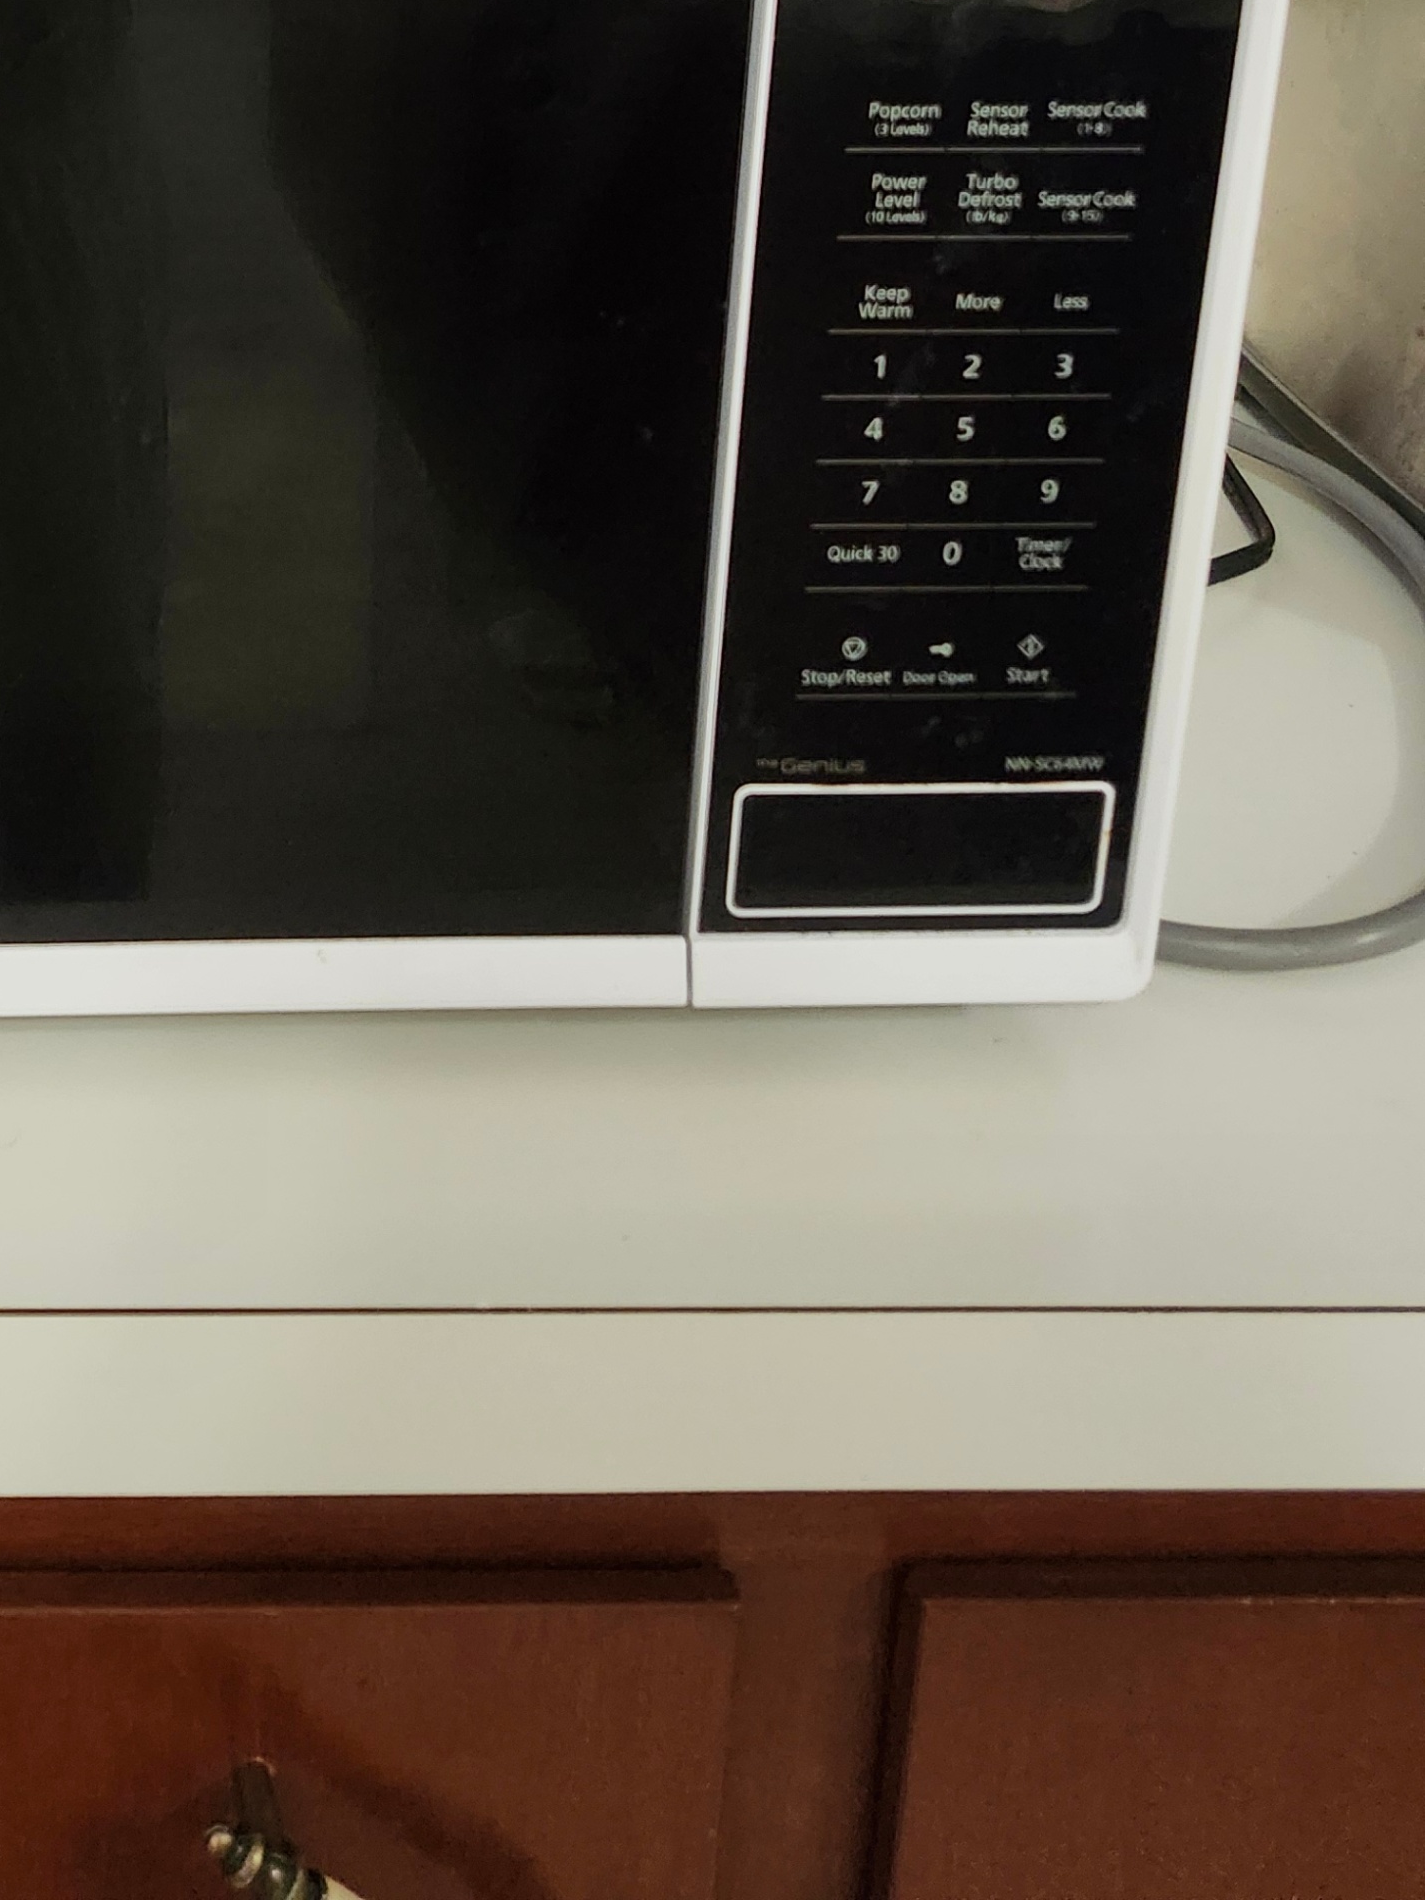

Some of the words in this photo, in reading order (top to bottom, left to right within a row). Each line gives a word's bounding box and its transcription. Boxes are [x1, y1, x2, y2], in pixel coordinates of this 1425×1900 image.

[868, 101, 942, 122] Popcorn
[970, 101, 1028, 118] Sensor
[1047, 101, 1102, 118] Sensor
[1103, 101, 1147, 118] Cook
[874, 122, 889, 137] (3
[891, 122, 933, 137] Levels)
[967, 119, 1029, 137] Reheat
[871, 173, 927, 190] Power
[966, 173, 1019, 190] Turbo
[875, 191, 921, 209] Level
[958, 191, 1023, 208] Defrost
[1038, 191, 1092, 208] Sensor
[1093, 191, 1137, 208] Cook
[886, 210, 927, 224] Levels)
[864, 285, 911, 304] Keep
[955, 293, 1004, 311] More
[1053, 293, 1091, 310] Less
[858, 302, 913, 319] Warm
[874, 354, 887, 379] 1
[962, 354, 982, 379] 2
[1054, 353, 1074, 379] 3
[864, 417, 884, 441] 4
[956, 416, 975, 441] 5
[1047, 415, 1067, 441] 6
[861, 480, 880, 505] 7
[949, 480, 969, 505] 8
[1040, 479, 1060, 504] 9
[942, 541, 963, 566] 0
[1015, 536, 1073, 553] Timer/
[827, 545, 873, 564] Quick
[877, 545, 901, 563] 30
[1018, 553, 1064, 571] Clock
[801, 668, 893, 687] Stop/Reset
[902, 670, 936, 685] Door
[938, 670, 976, 686] Open
[1006, 667, 1050, 685] Start
[780, 757, 866, 774] Genius
